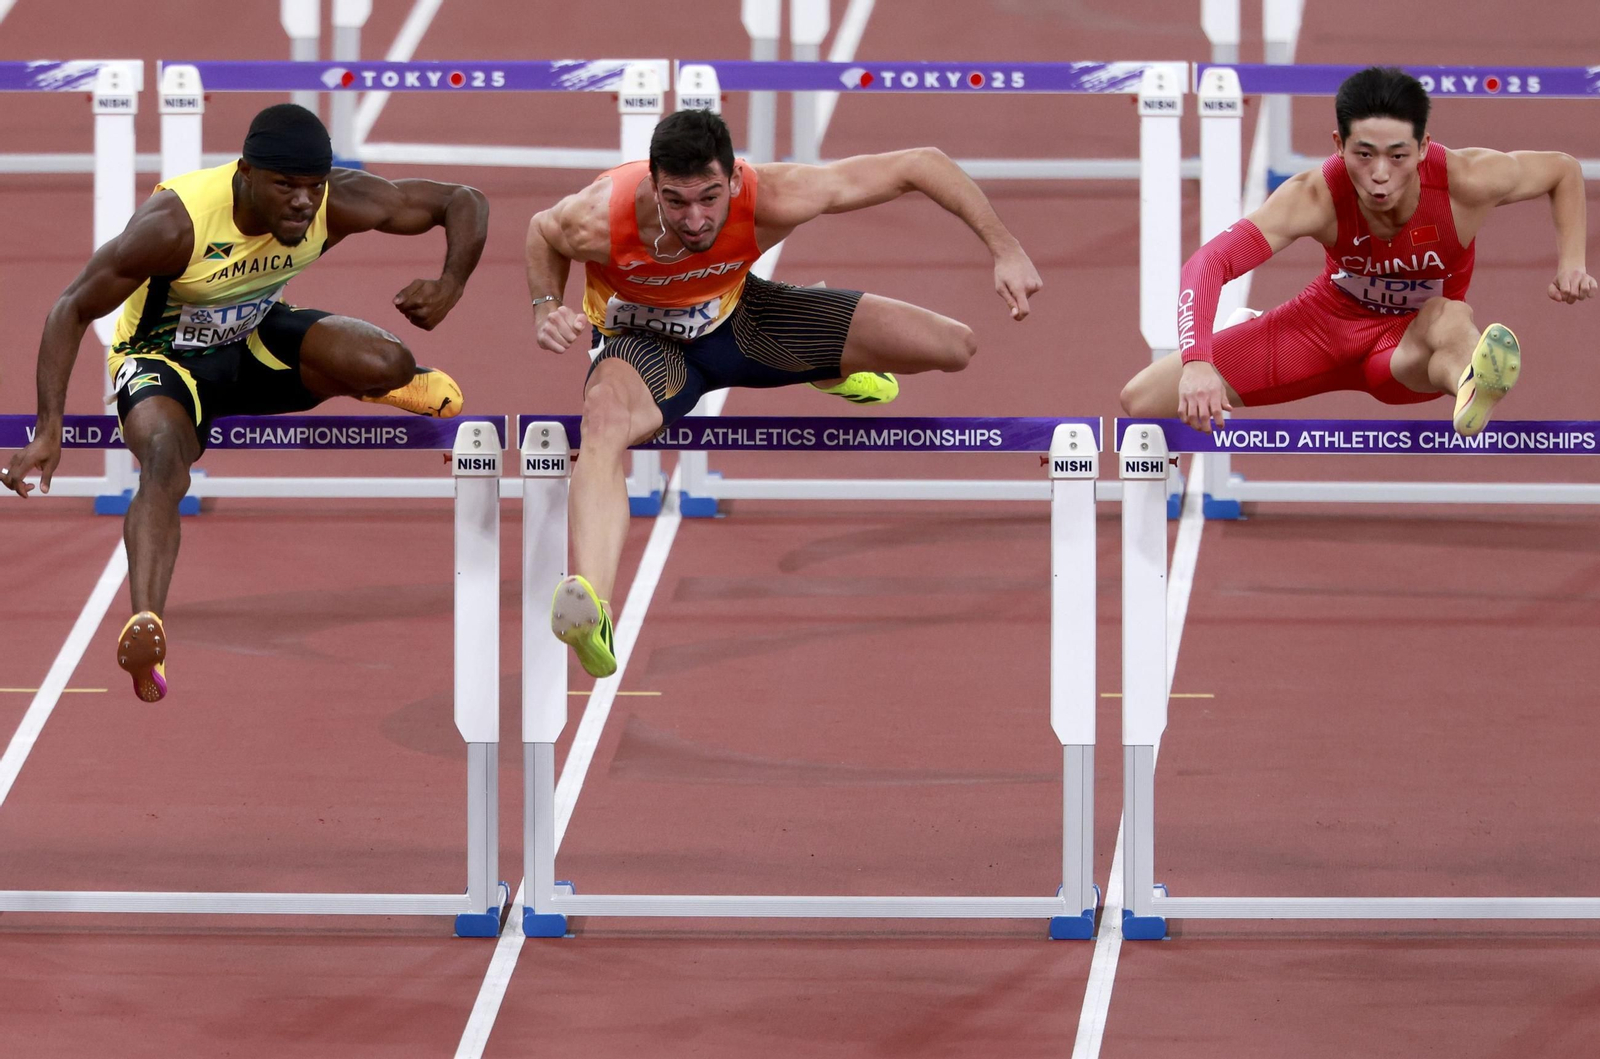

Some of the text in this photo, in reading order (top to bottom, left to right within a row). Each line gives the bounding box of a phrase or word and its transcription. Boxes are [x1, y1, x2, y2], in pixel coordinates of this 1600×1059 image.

[164, 98, 198, 108] NISHI
[625, 97, 659, 108] NISHI
[206, 254, 293, 284] JAMAICA
[1341, 250, 1446, 275] CHINA
[1369, 276, 1434, 292] TDK
[1363, 288, 1408, 306] LIU
[213, 298, 273, 325] TDK
[638, 301, 712, 320] TDK
[1178, 288, 1196, 352] CHINA
[26, 426, 101, 444] WRLD
[230, 427, 408, 444] CHAMPIONSHIPS
[700, 428, 816, 446] ATHLETICS
[823, 429, 1003, 446] CHAMPIONSHIPS
[1213, 430, 1596, 449] WORLD ATHLETICS CHAMPIONSHIPS
[458, 458, 496, 471] NISHI
[526, 458, 565, 471] NISHI
[1054, 460, 1092, 472] NISHI
[1125, 461, 1164, 473] NISHI
